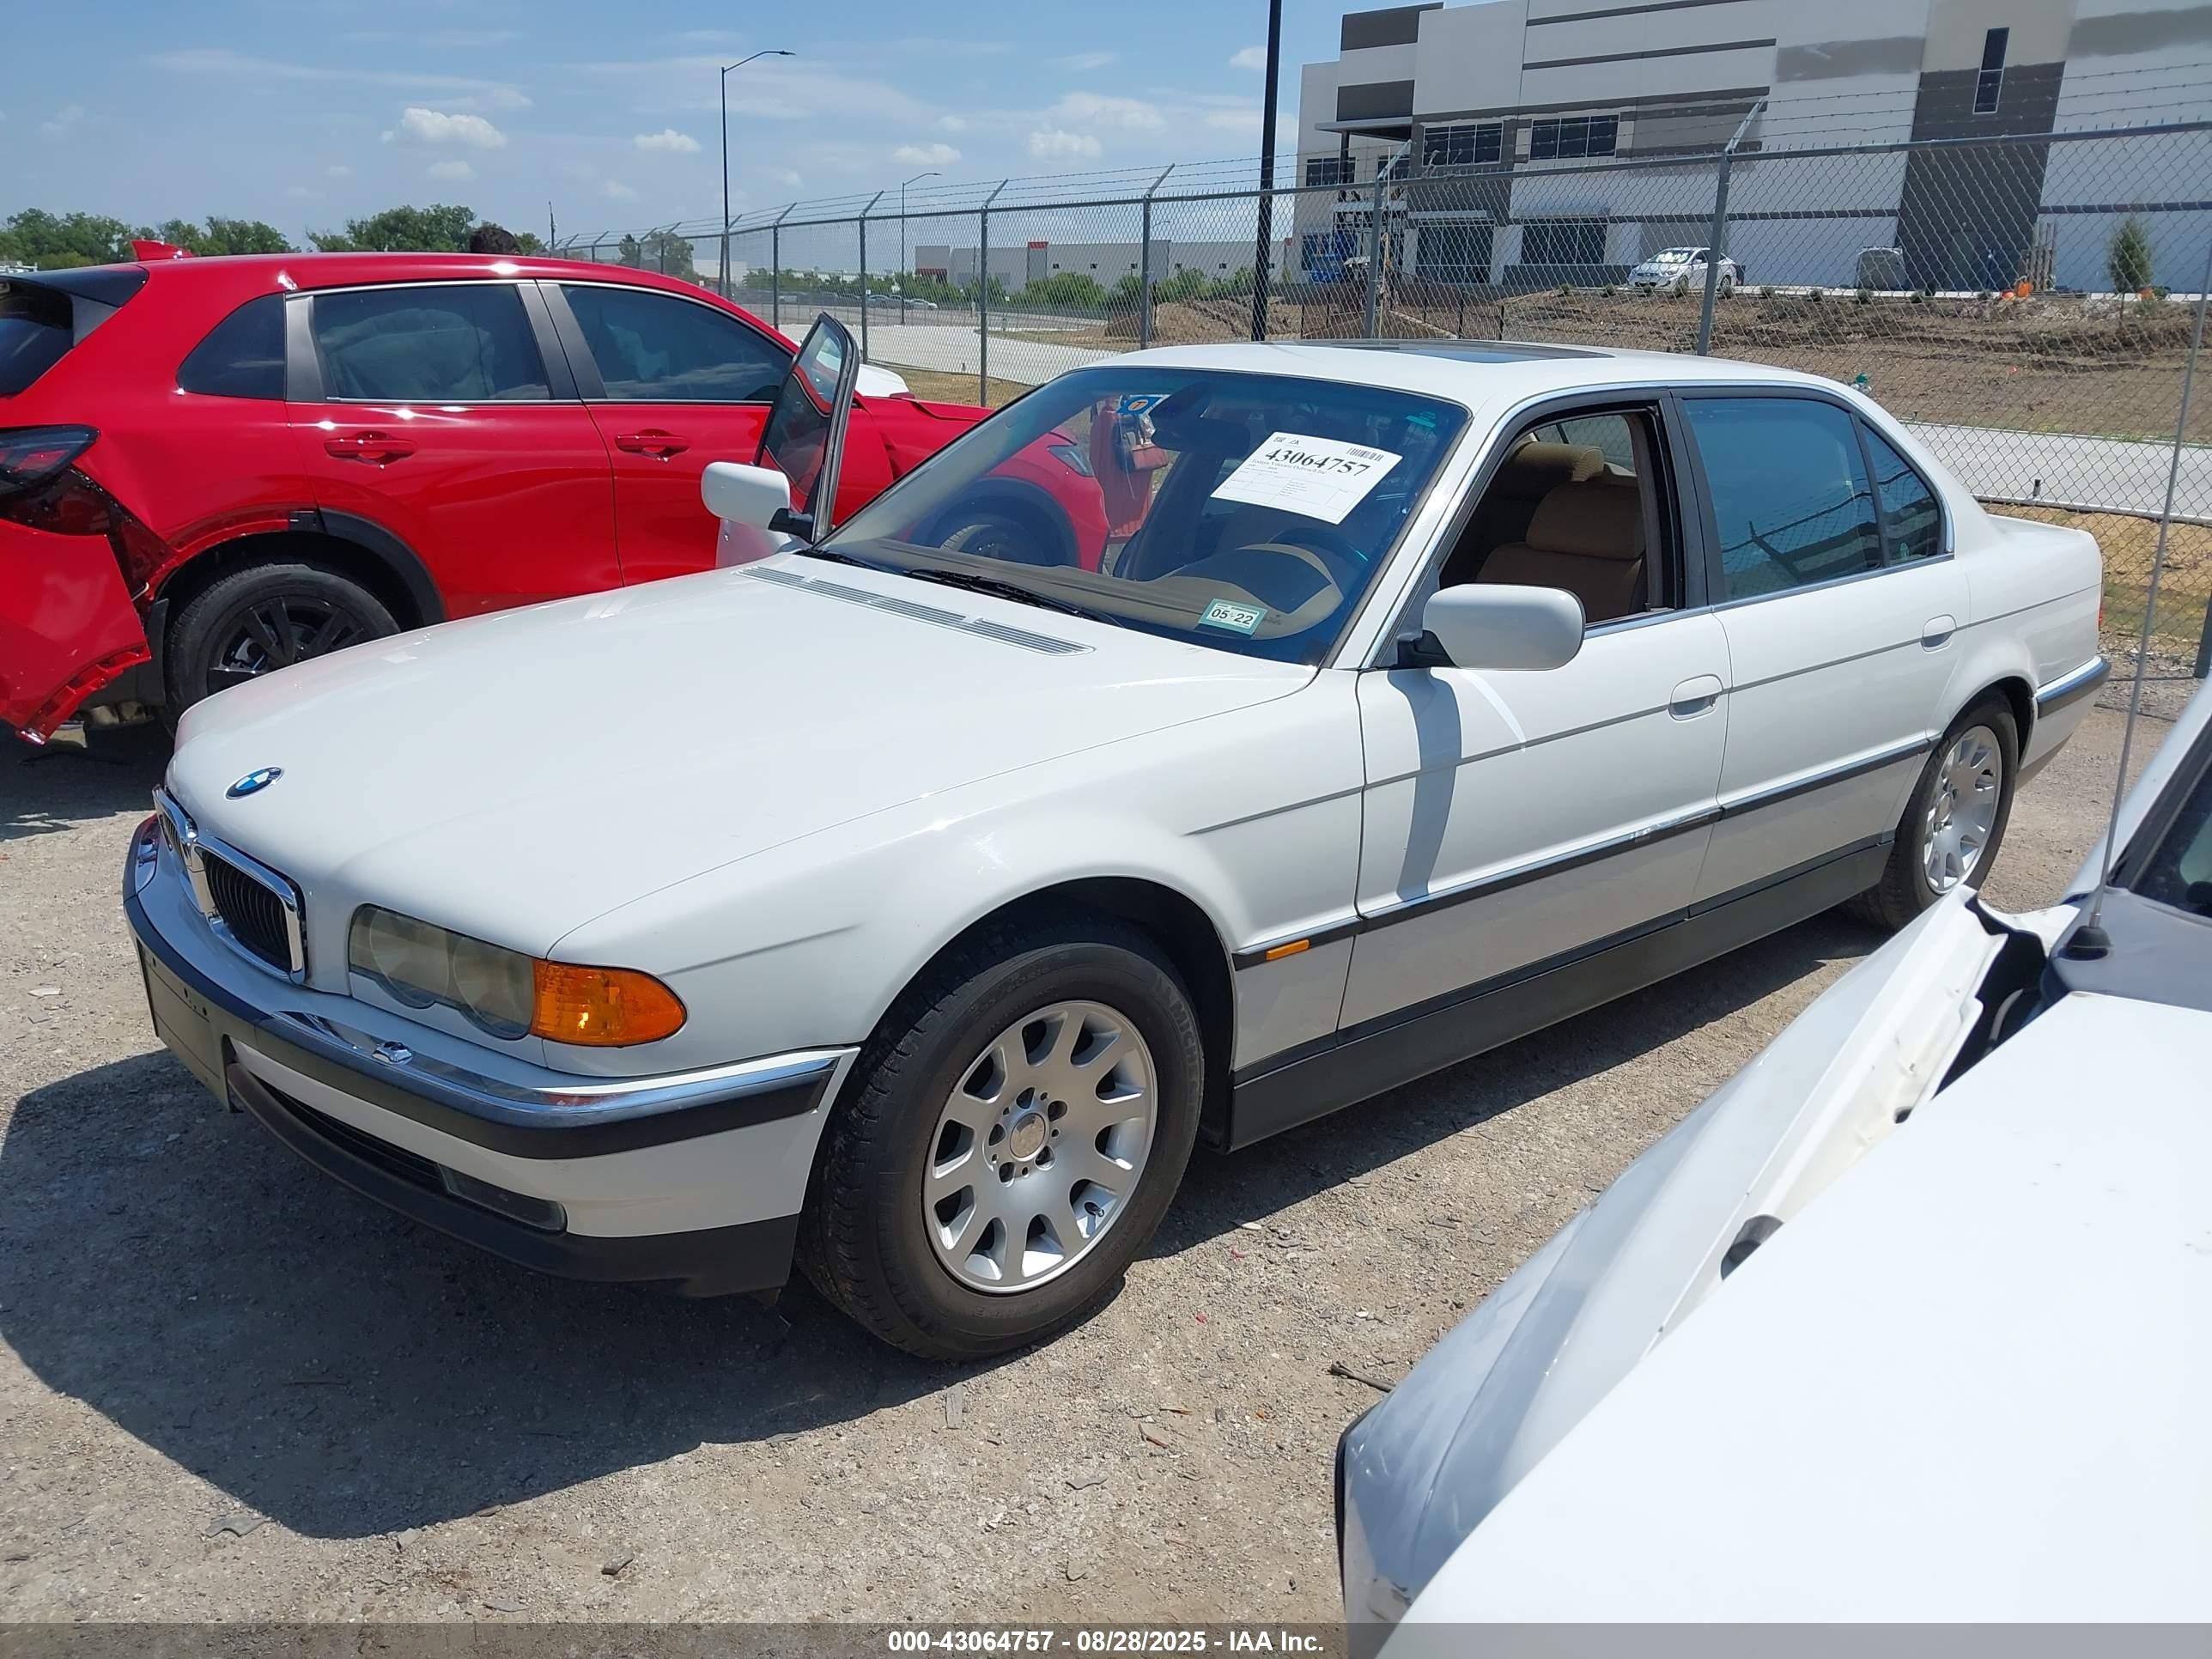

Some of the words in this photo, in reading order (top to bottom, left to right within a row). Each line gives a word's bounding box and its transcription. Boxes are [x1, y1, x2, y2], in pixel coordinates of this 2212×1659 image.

[1265, 447, 1371, 477] 43064757
[1211, 608, 1231, 619] 05
[1233, 613, 1254, 625] 22
